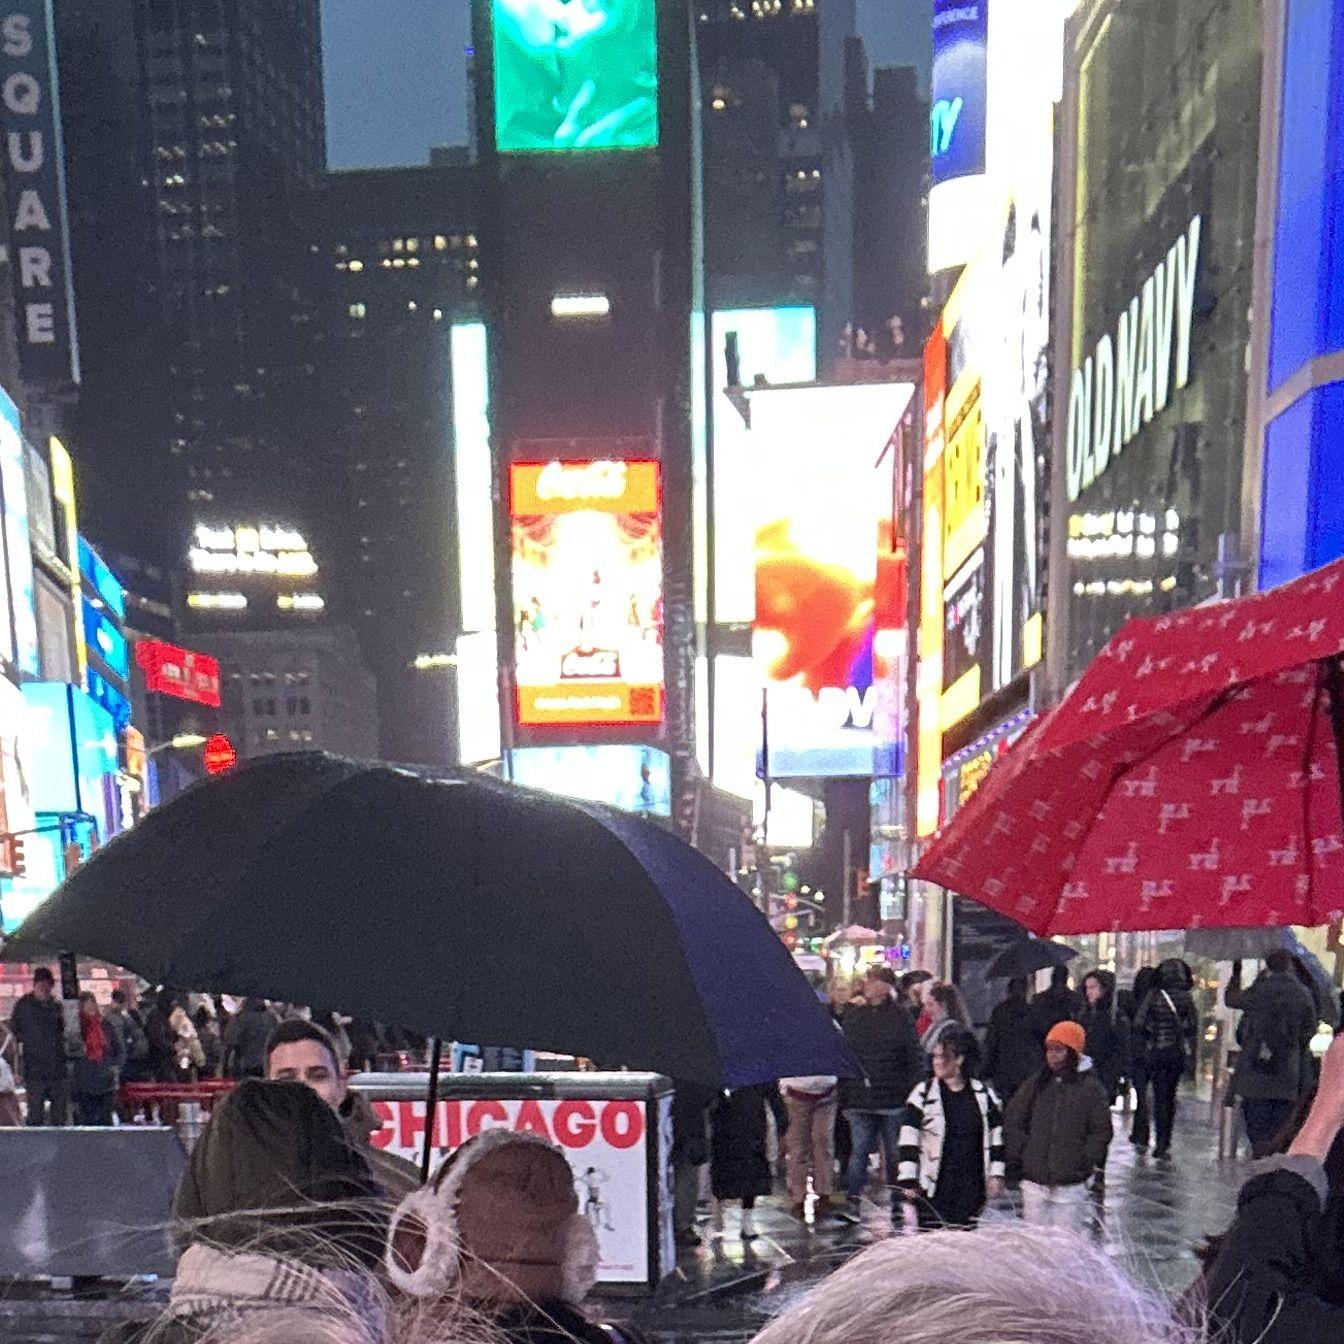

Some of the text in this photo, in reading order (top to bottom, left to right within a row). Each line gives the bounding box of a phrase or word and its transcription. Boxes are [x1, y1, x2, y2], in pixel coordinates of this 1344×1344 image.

[2, 14, 56, 344] SQUARE
[1066, 214, 1202, 501] OLD NAVY
